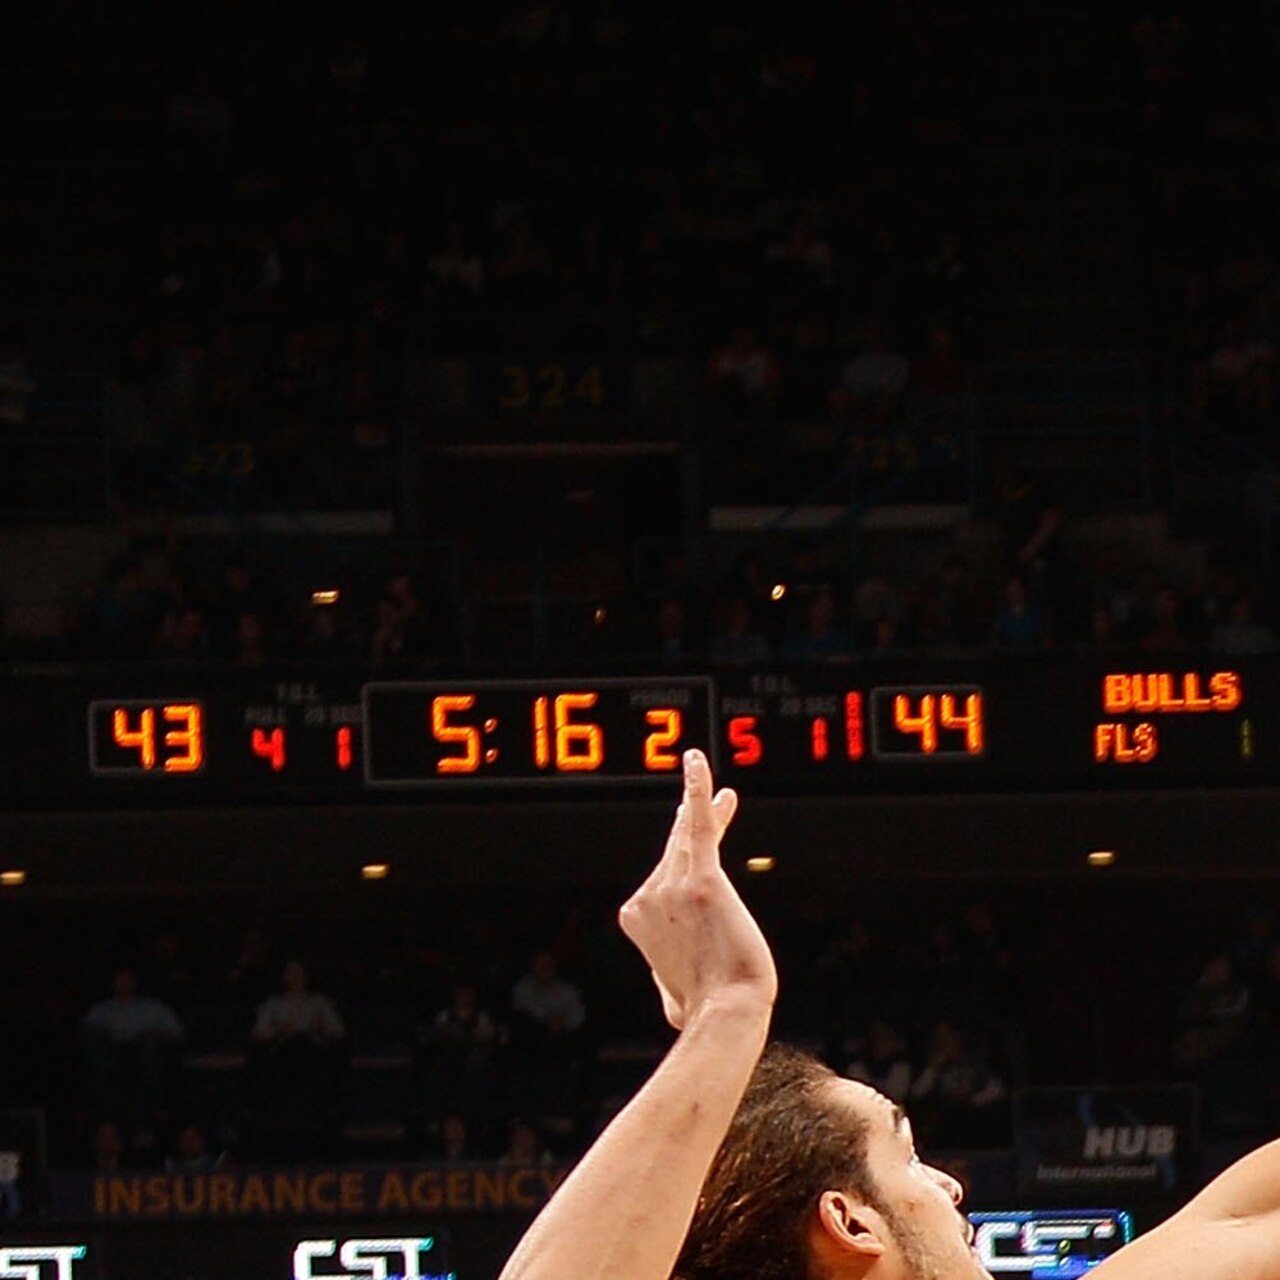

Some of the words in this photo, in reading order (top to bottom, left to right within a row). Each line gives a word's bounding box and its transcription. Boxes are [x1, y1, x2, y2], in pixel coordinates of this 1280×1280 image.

[1102, 671, 1242, 715] BULLS
[110, 703, 205, 775] 43
[251, 724, 289, 773] 4
[336, 723, 355, 772] 1
[430, 690, 607, 775] 5:16
[642, 706, 683, 772] 2
[728, 715, 763, 767] 5
[811, 717, 828, 762] 1
[894, 693, 983, 755] 44
[1093, 721, 1159, 763] FLS
[1083, 1124, 1176, 1158] HUB
[94, 1173, 364, 1214] INSURANCE
